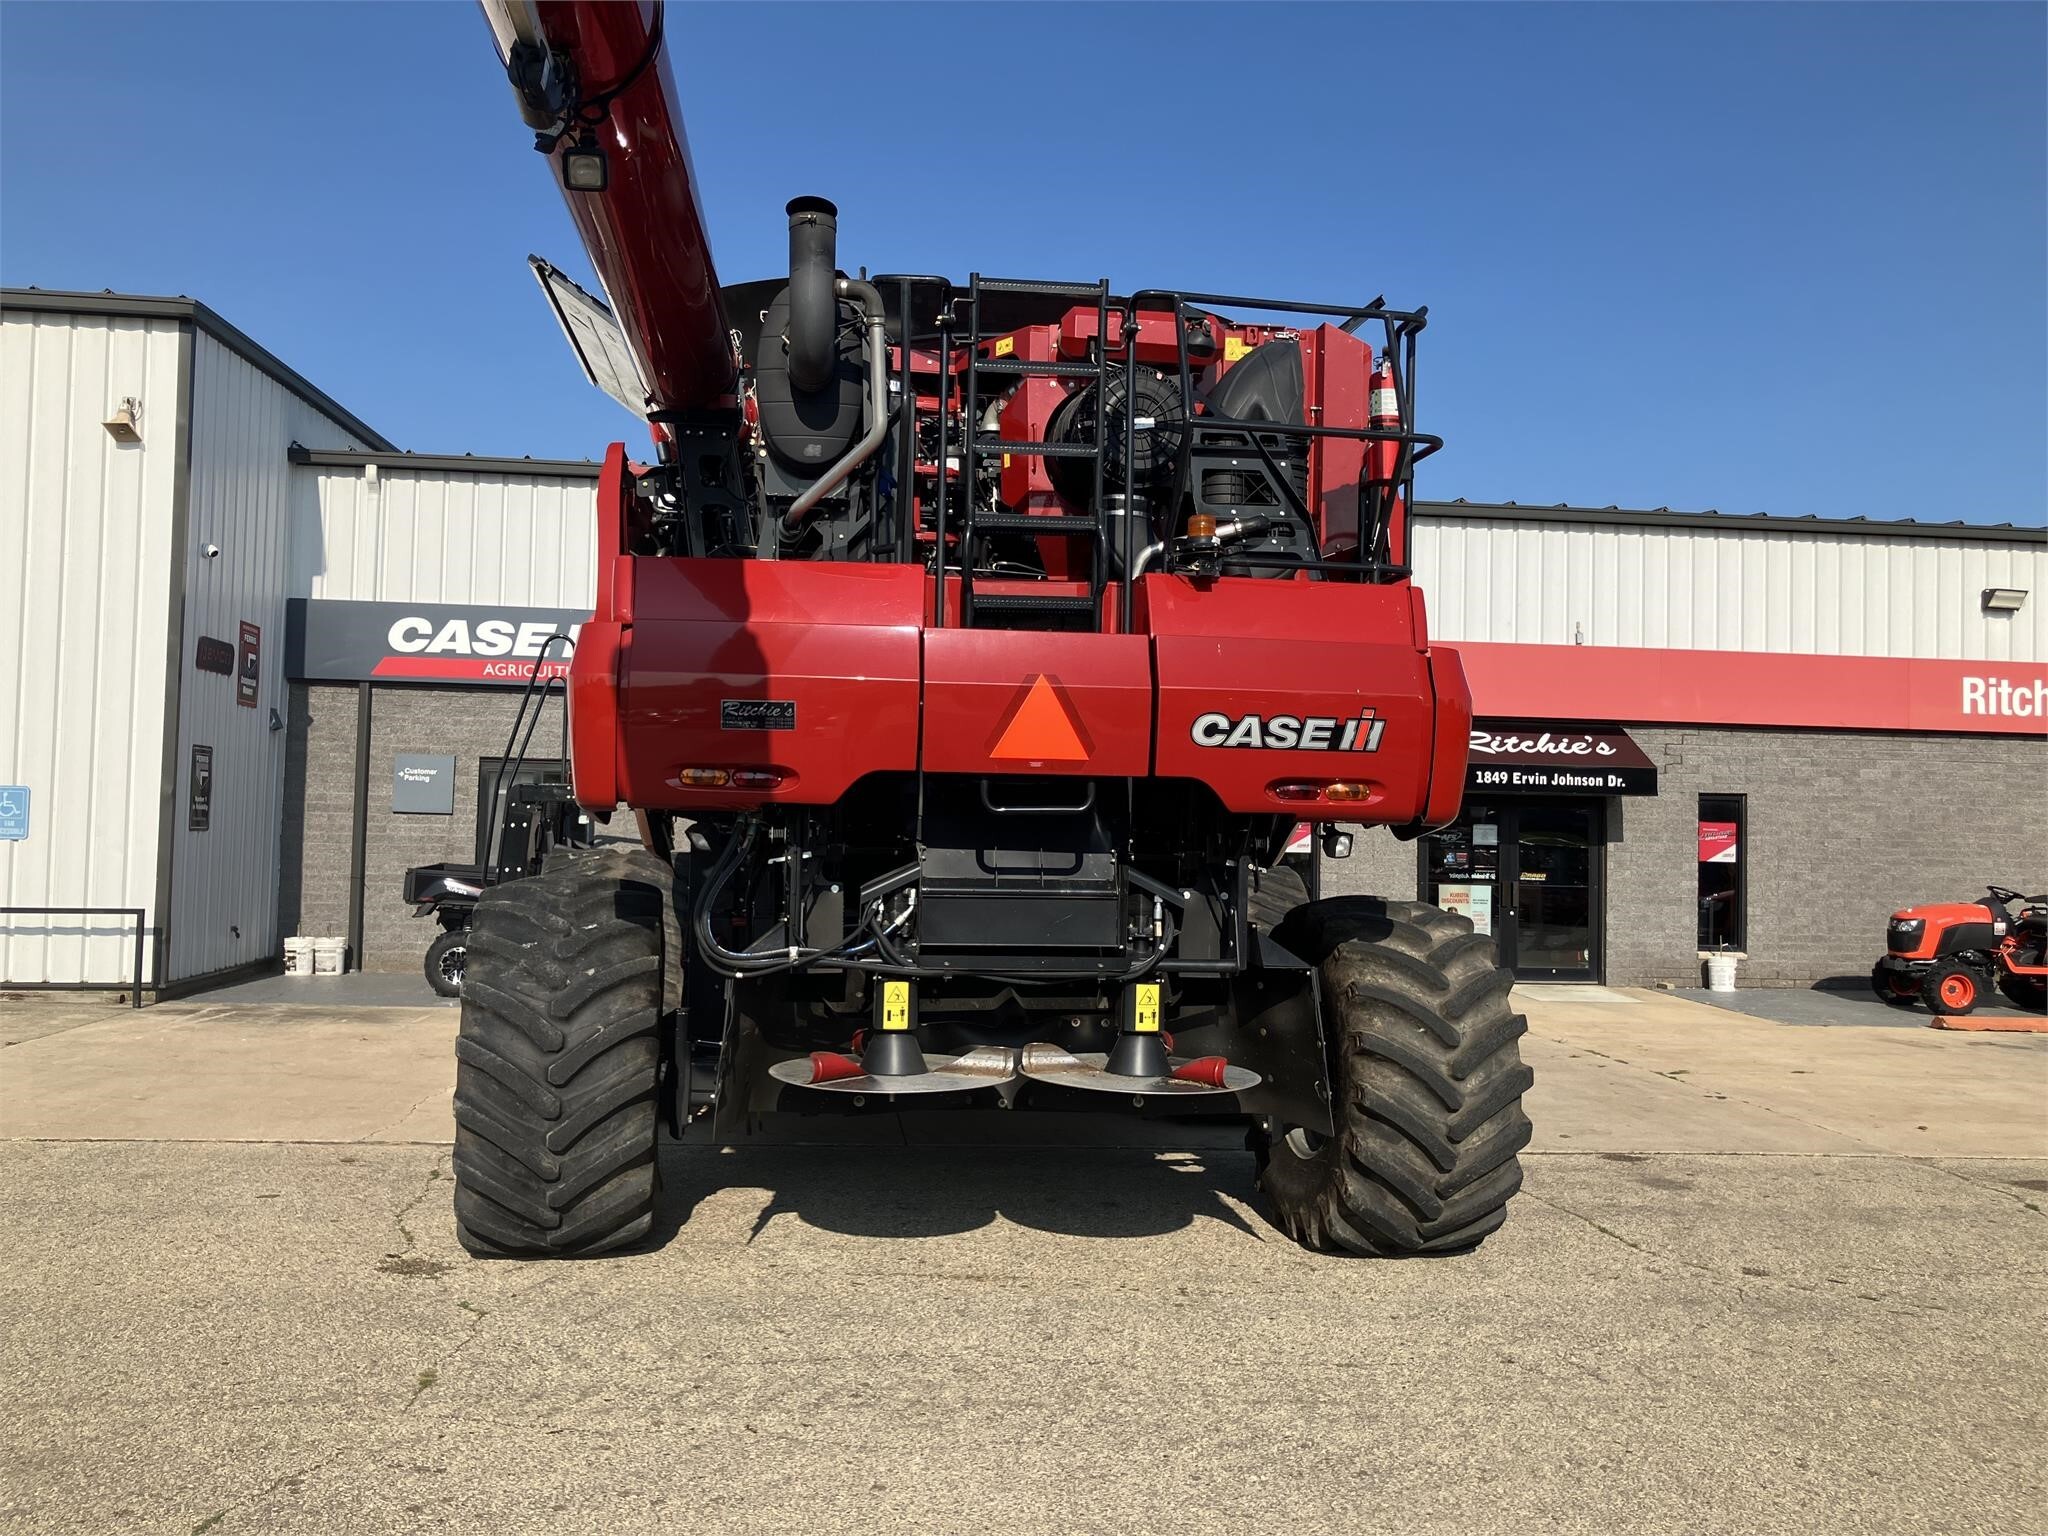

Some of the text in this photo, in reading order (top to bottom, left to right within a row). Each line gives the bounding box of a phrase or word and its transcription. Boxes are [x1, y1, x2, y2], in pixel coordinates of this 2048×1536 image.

[387, 617, 558, 657] CASE
[483, 663, 570, 678] AGRICULT
[1962, 676, 2048, 717] Ritch
[723, 702, 794, 716] Ritchie's
[1190, 713, 1337, 750] CASE
[1469, 731, 1616, 756] Ritchie's
[404, 774, 430, 783] Parking
[1475, 771, 1626, 788] 1849 Ervin Johnson Dr.
